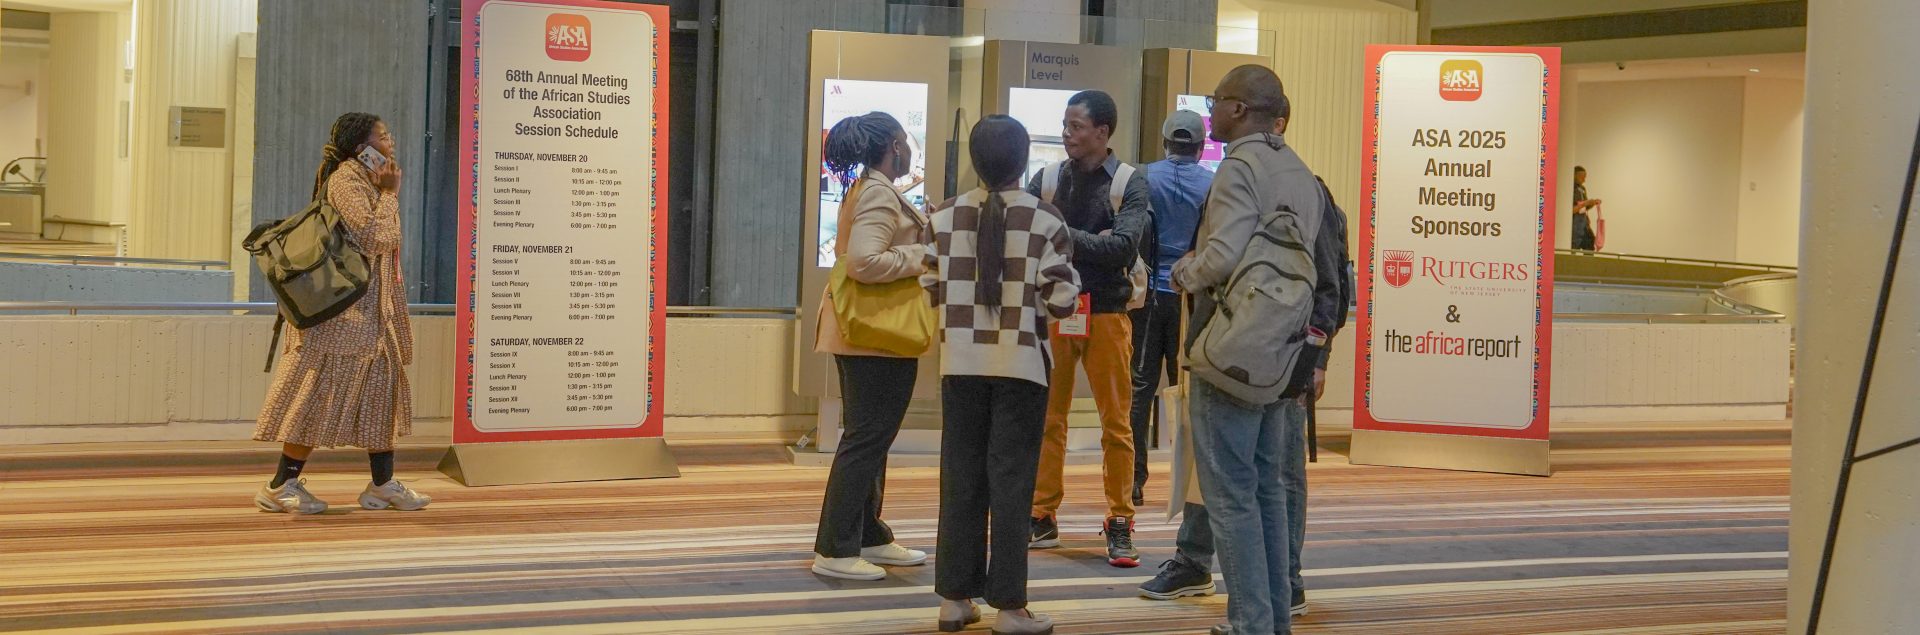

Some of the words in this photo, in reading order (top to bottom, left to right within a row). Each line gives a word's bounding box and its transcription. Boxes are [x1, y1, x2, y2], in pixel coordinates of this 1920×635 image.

[557, 26, 587, 46] ASA
[1032, 52, 1080, 67] Marquis
[505, 69, 534, 83] 68th
[537, 71, 578, 85] Annual
[582, 73, 628, 90] Meeting
[1031, 69, 1063, 81] Level
[1450, 70, 1479, 87] ASA
[503, 86, 516, 100] of
[519, 87, 538, 101] the
[542, 88, 584, 102] African
[587, 88, 630, 105] Studies
[533, 106, 601, 120] Association
[515, 122, 562, 136] Session
[565, 125, 619, 139] Schedule
[1412, 128, 1452, 148] ASA
[1458, 130, 1506, 149] 2025
[494, 151, 535, 161] THURSDAY,
[536, 153, 577, 162] NOVEMBER
[579, 154, 588, 163] 20
[1424, 158, 1492, 178] Annual
[1419, 187, 1496, 211] Meeting
[1411, 216, 1501, 238] Sponsors
[492, 244, 521, 254] FRIDAY,
[522, 245, 563, 254] NOVEMBER
[564, 245, 573, 254] 21
[1421, 256, 1528, 285] RUTGERS
[1445, 304, 1461, 323] &
[490, 338, 531, 346] SATURDAY,
[532, 337, 573, 346] NOVEMBER
[574, 337, 584, 346] 22
[1384, 329, 1412, 353] the
[1416, 331, 1464, 356] africa
[1467, 336, 1521, 360] report
